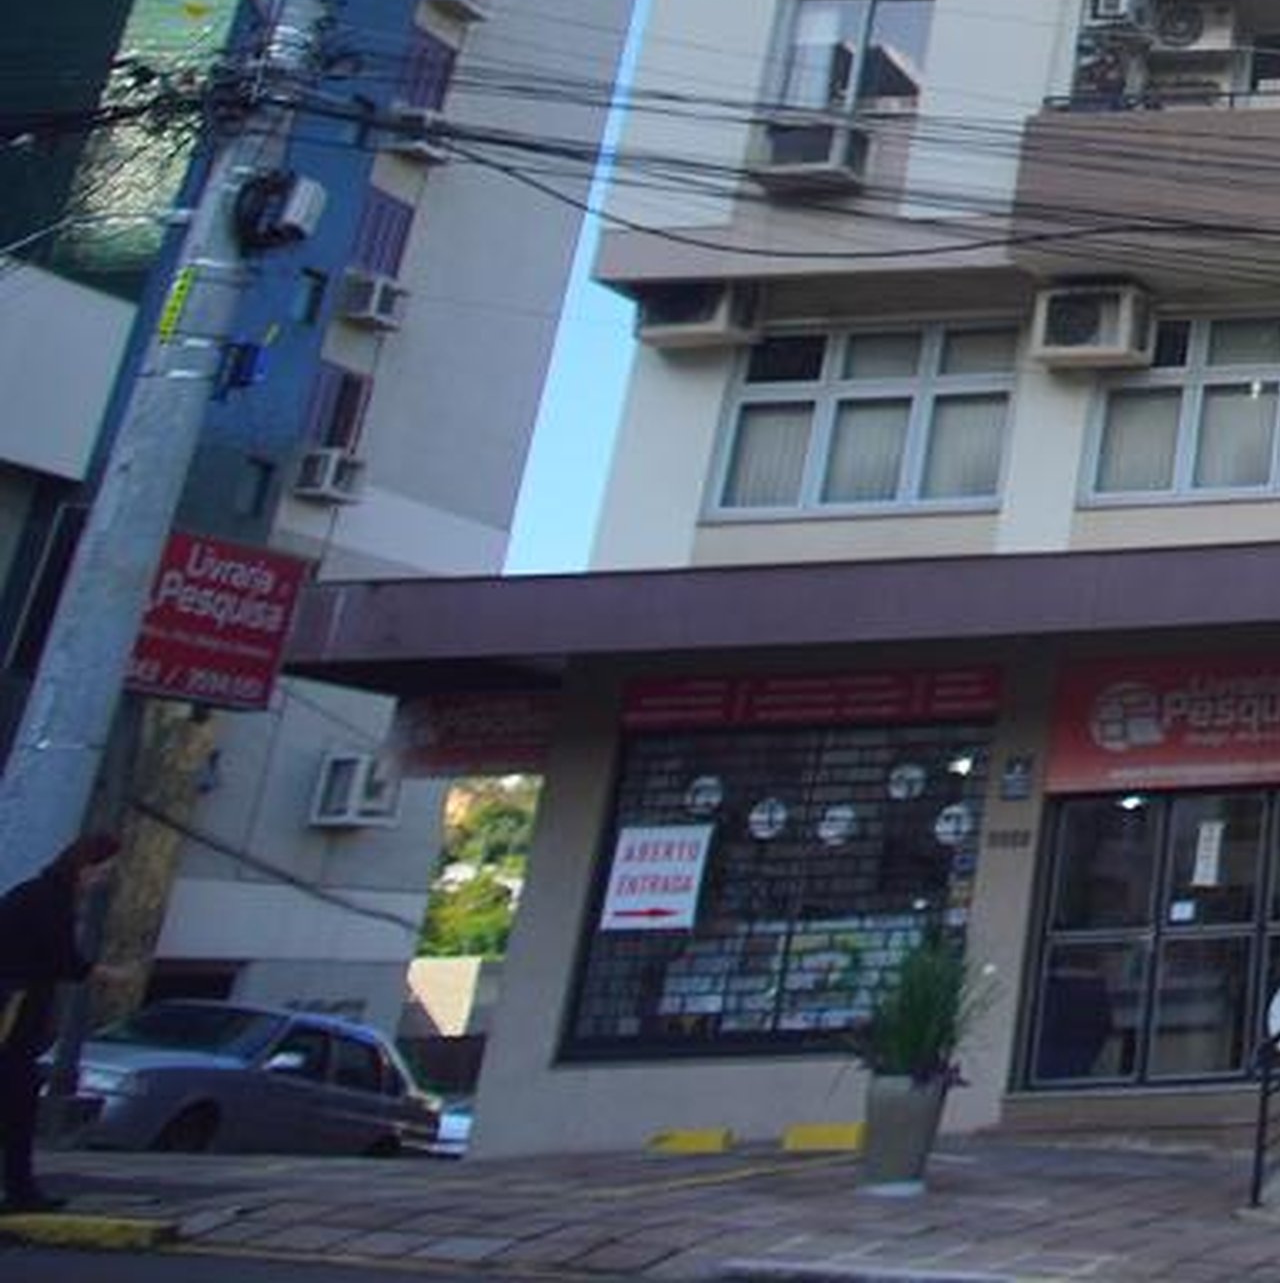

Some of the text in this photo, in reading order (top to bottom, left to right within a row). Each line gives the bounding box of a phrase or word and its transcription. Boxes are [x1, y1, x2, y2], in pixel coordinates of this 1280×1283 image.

[185, 541, 275, 594] Livraria
[157, 569, 285, 632] Pesquisa
[622, 840, 700, 863] ABERTO
[615, 873, 696, 898] ENTRADA
